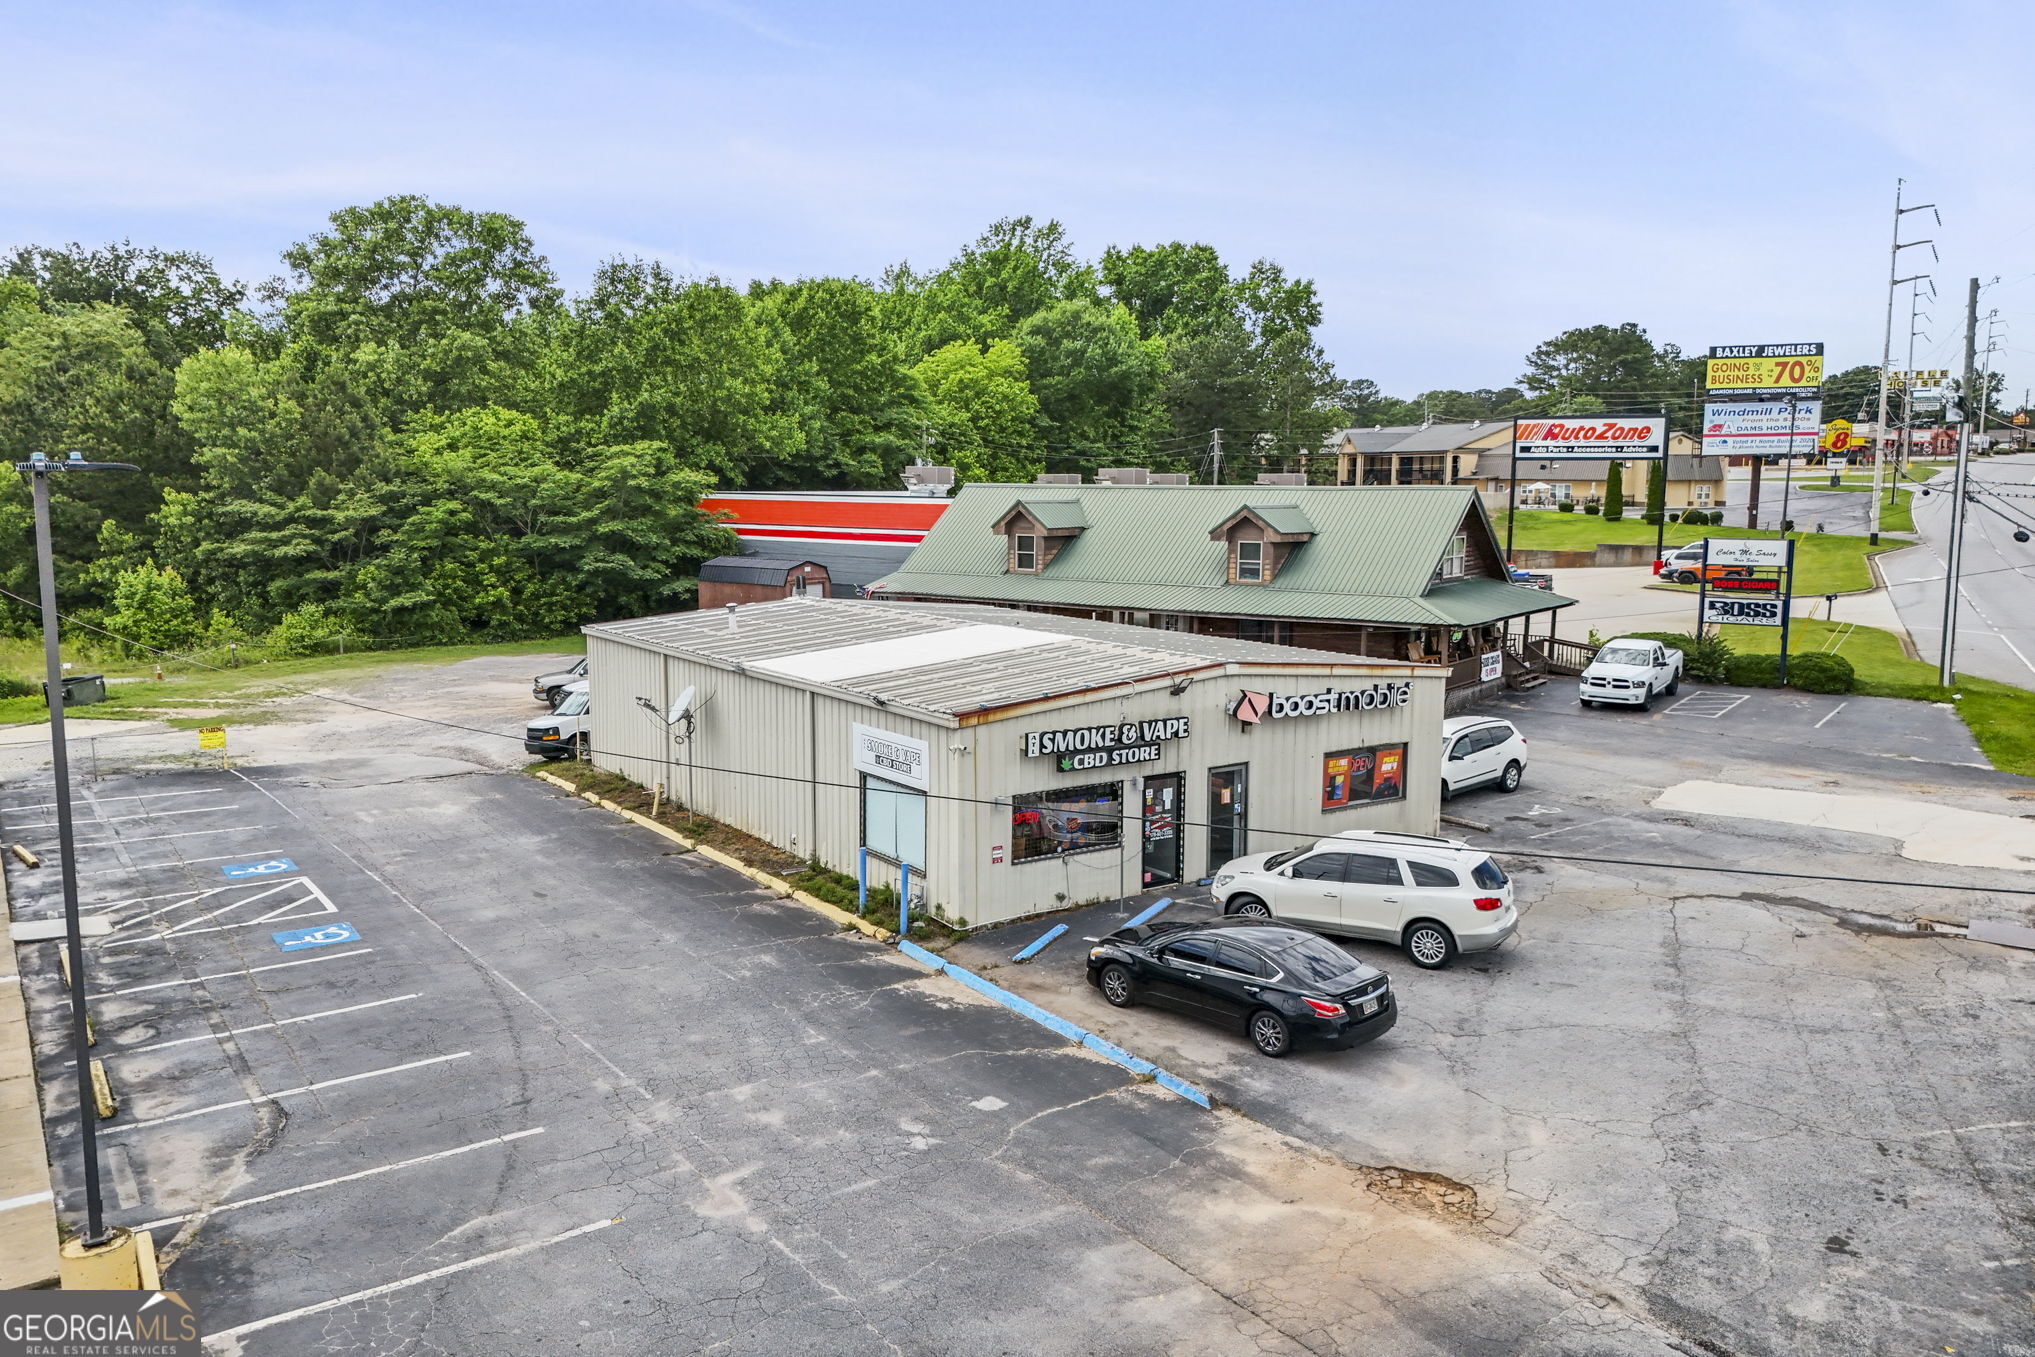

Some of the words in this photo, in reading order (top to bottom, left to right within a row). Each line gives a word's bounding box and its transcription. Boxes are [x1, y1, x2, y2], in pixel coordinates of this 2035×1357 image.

[1716, 346, 1758, 358] BAXLEY
[1762, 344, 1817, 357] JEWELERS
[1711, 362, 1750, 374] GOING
[1879, 369, 1949, 379] AFFLE
[1710, 374, 1763, 385] BUSINESS
[1711, 407, 1772, 416] Windmill
[1541, 422, 1652, 442] AutoZone
[1831, 431, 1850, 450] 8
[1716, 549, 1736, 557] Color
[1738, 549, 1753, 557] Me
[1755, 550, 1778, 558] Sassy
[1713, 580, 1739, 588] BOSS
[1741, 581, 1777, 590] CIGARS
[1708, 600, 1778, 618] BOSS
[1707, 615, 1777, 624] CIGARS
[1041, 726, 1116, 754] SMOKE
[1121, 724, 1137, 745] &
[1142, 717, 1190, 742] VAPE
[867, 739, 893, 757] SMOKE
[902, 748, 921, 766] VAPE
[1073, 752, 1108, 770] CBD
[1111, 745, 1159, 765] STORE
[880, 757, 892, 767] CBD
[893, 761, 911, 774] STORE
[1351, 757, 1370, 772] OPEN
[1012, 812, 1039, 824] OPEN
